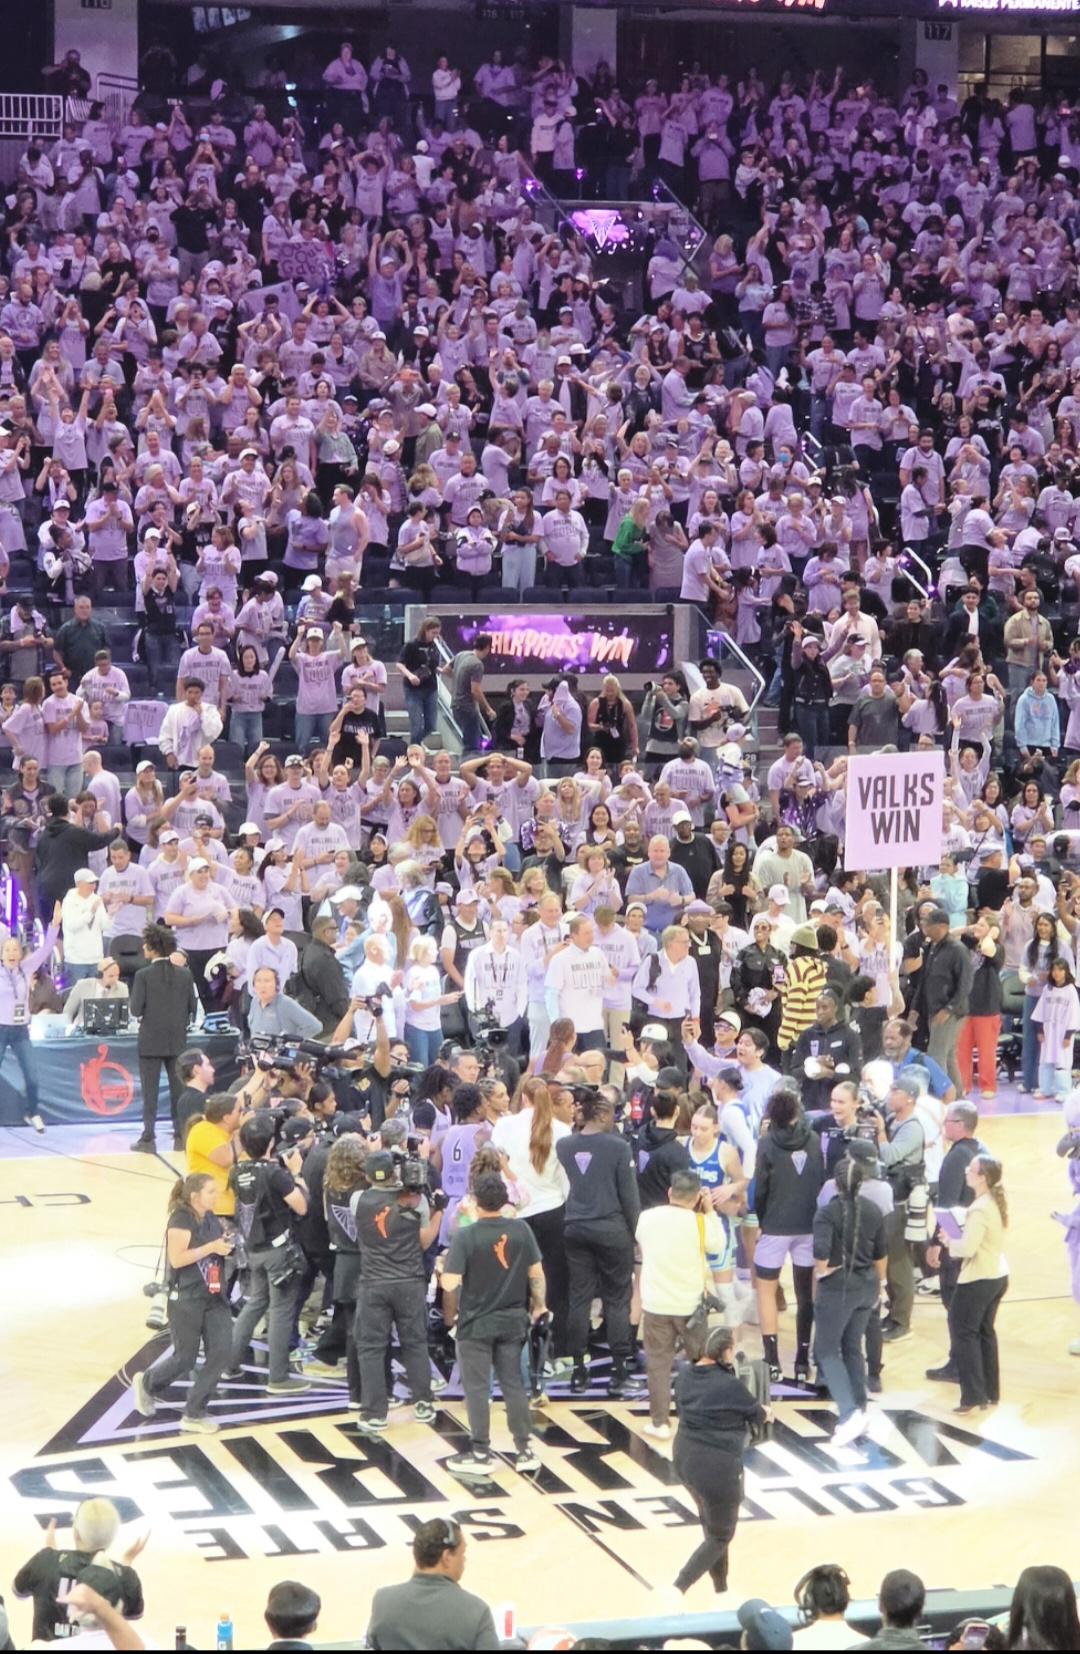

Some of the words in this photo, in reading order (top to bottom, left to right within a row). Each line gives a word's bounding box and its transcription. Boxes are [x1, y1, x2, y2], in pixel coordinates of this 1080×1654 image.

[928, 23, 950, 39] 117
[589, 632, 635, 666] WIN
[857, 772, 935, 810] VALKS
[870, 808, 921, 845] WIN
[453, 1138, 462, 1162] 6
